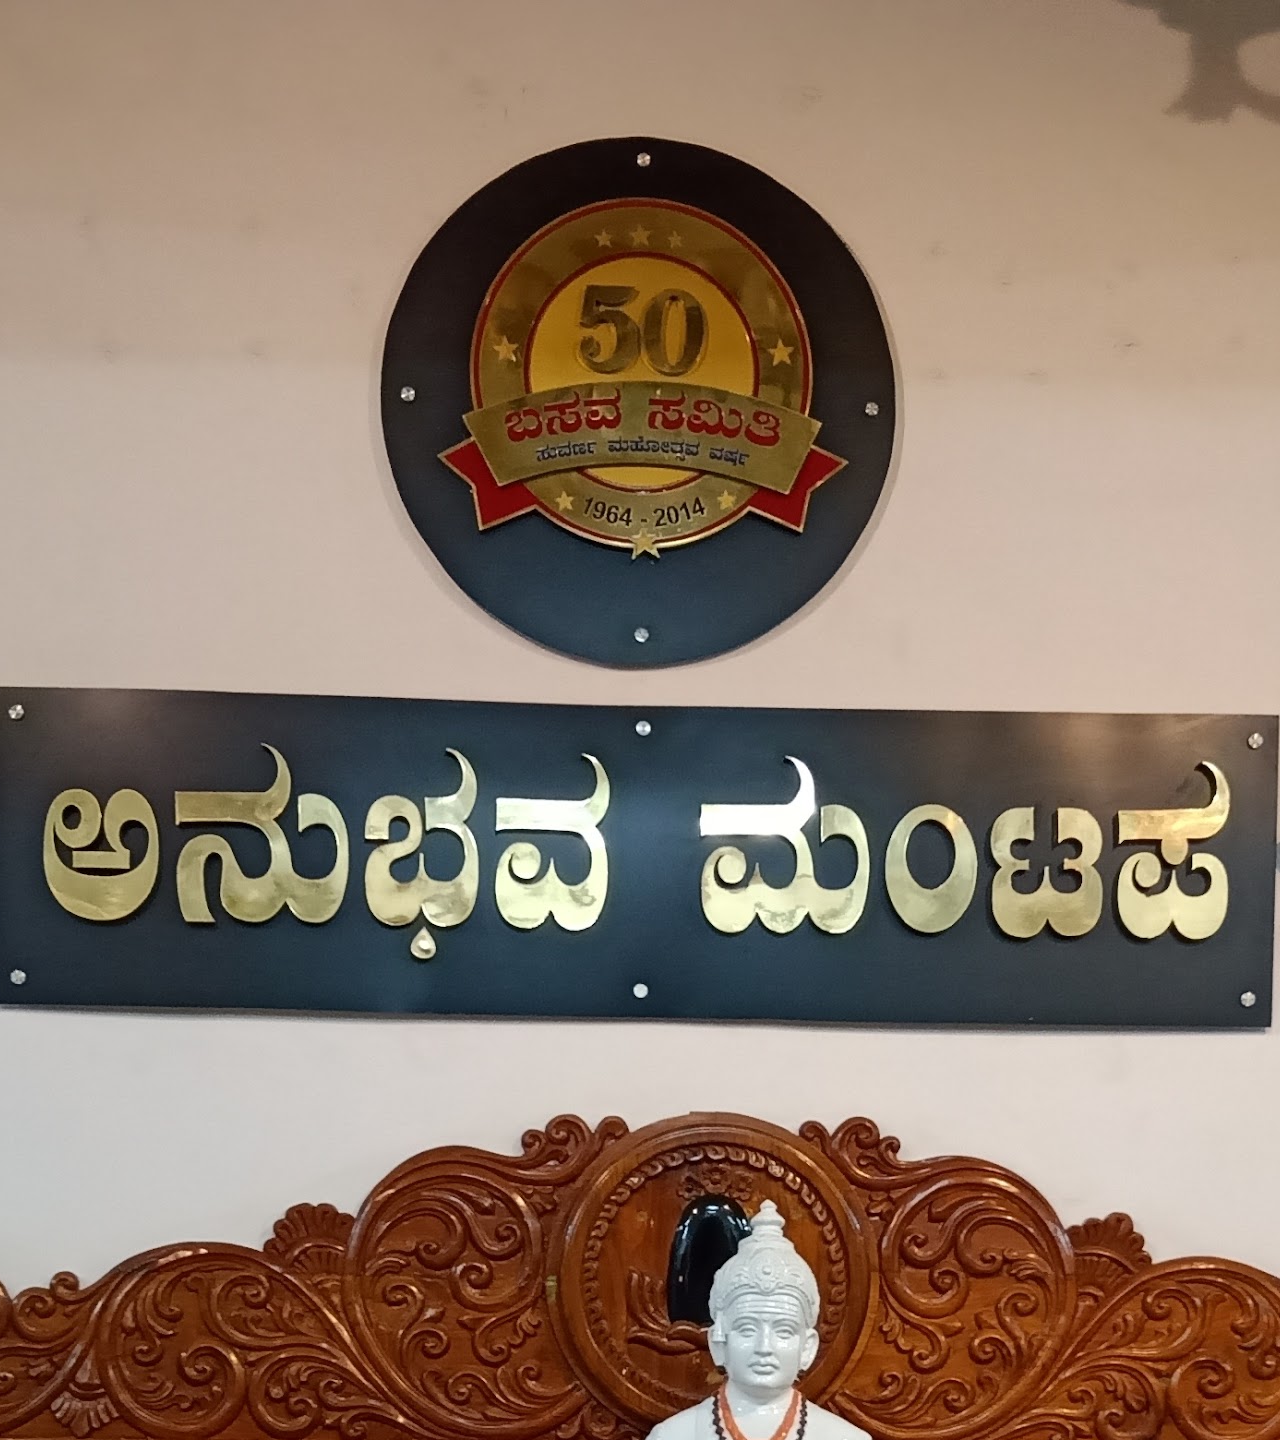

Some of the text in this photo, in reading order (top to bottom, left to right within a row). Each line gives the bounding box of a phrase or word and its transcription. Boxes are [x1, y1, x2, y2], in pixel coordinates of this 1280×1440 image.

[576, 283, 708, 376] 50
[504, 388, 783, 448] ಬಸವ ಸಮಿತಿ
[536, 442, 595, 463] ಸುವರ್ಣ
[710, 446, 749, 468] ವರ್ಷ
[583, 496, 633, 527] 1964
[654, 496, 707, 528] 2014
[42, 742, 1232, 960] ಅನುಭವ ಮಂಟಪ
